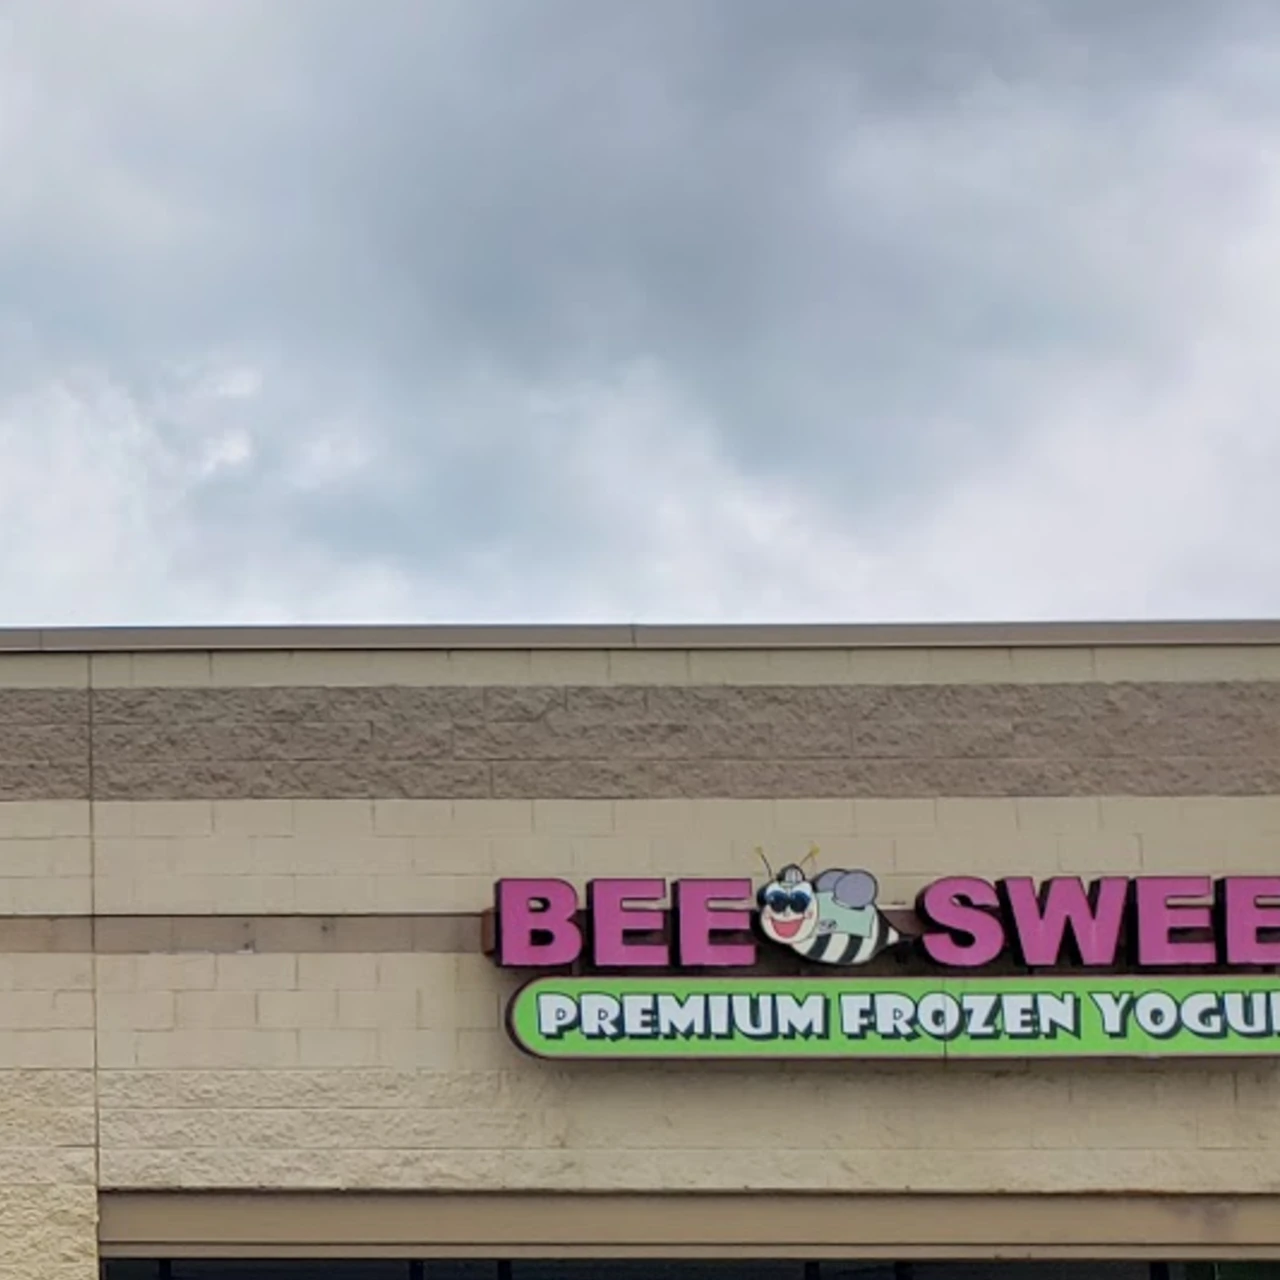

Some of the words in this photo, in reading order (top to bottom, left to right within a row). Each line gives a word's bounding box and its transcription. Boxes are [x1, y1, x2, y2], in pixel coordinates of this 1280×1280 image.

[495, 877, 762, 967] BEE
[536, 991, 831, 1040] PREMIUM
[838, 991, 1080, 1040] FROZEN
